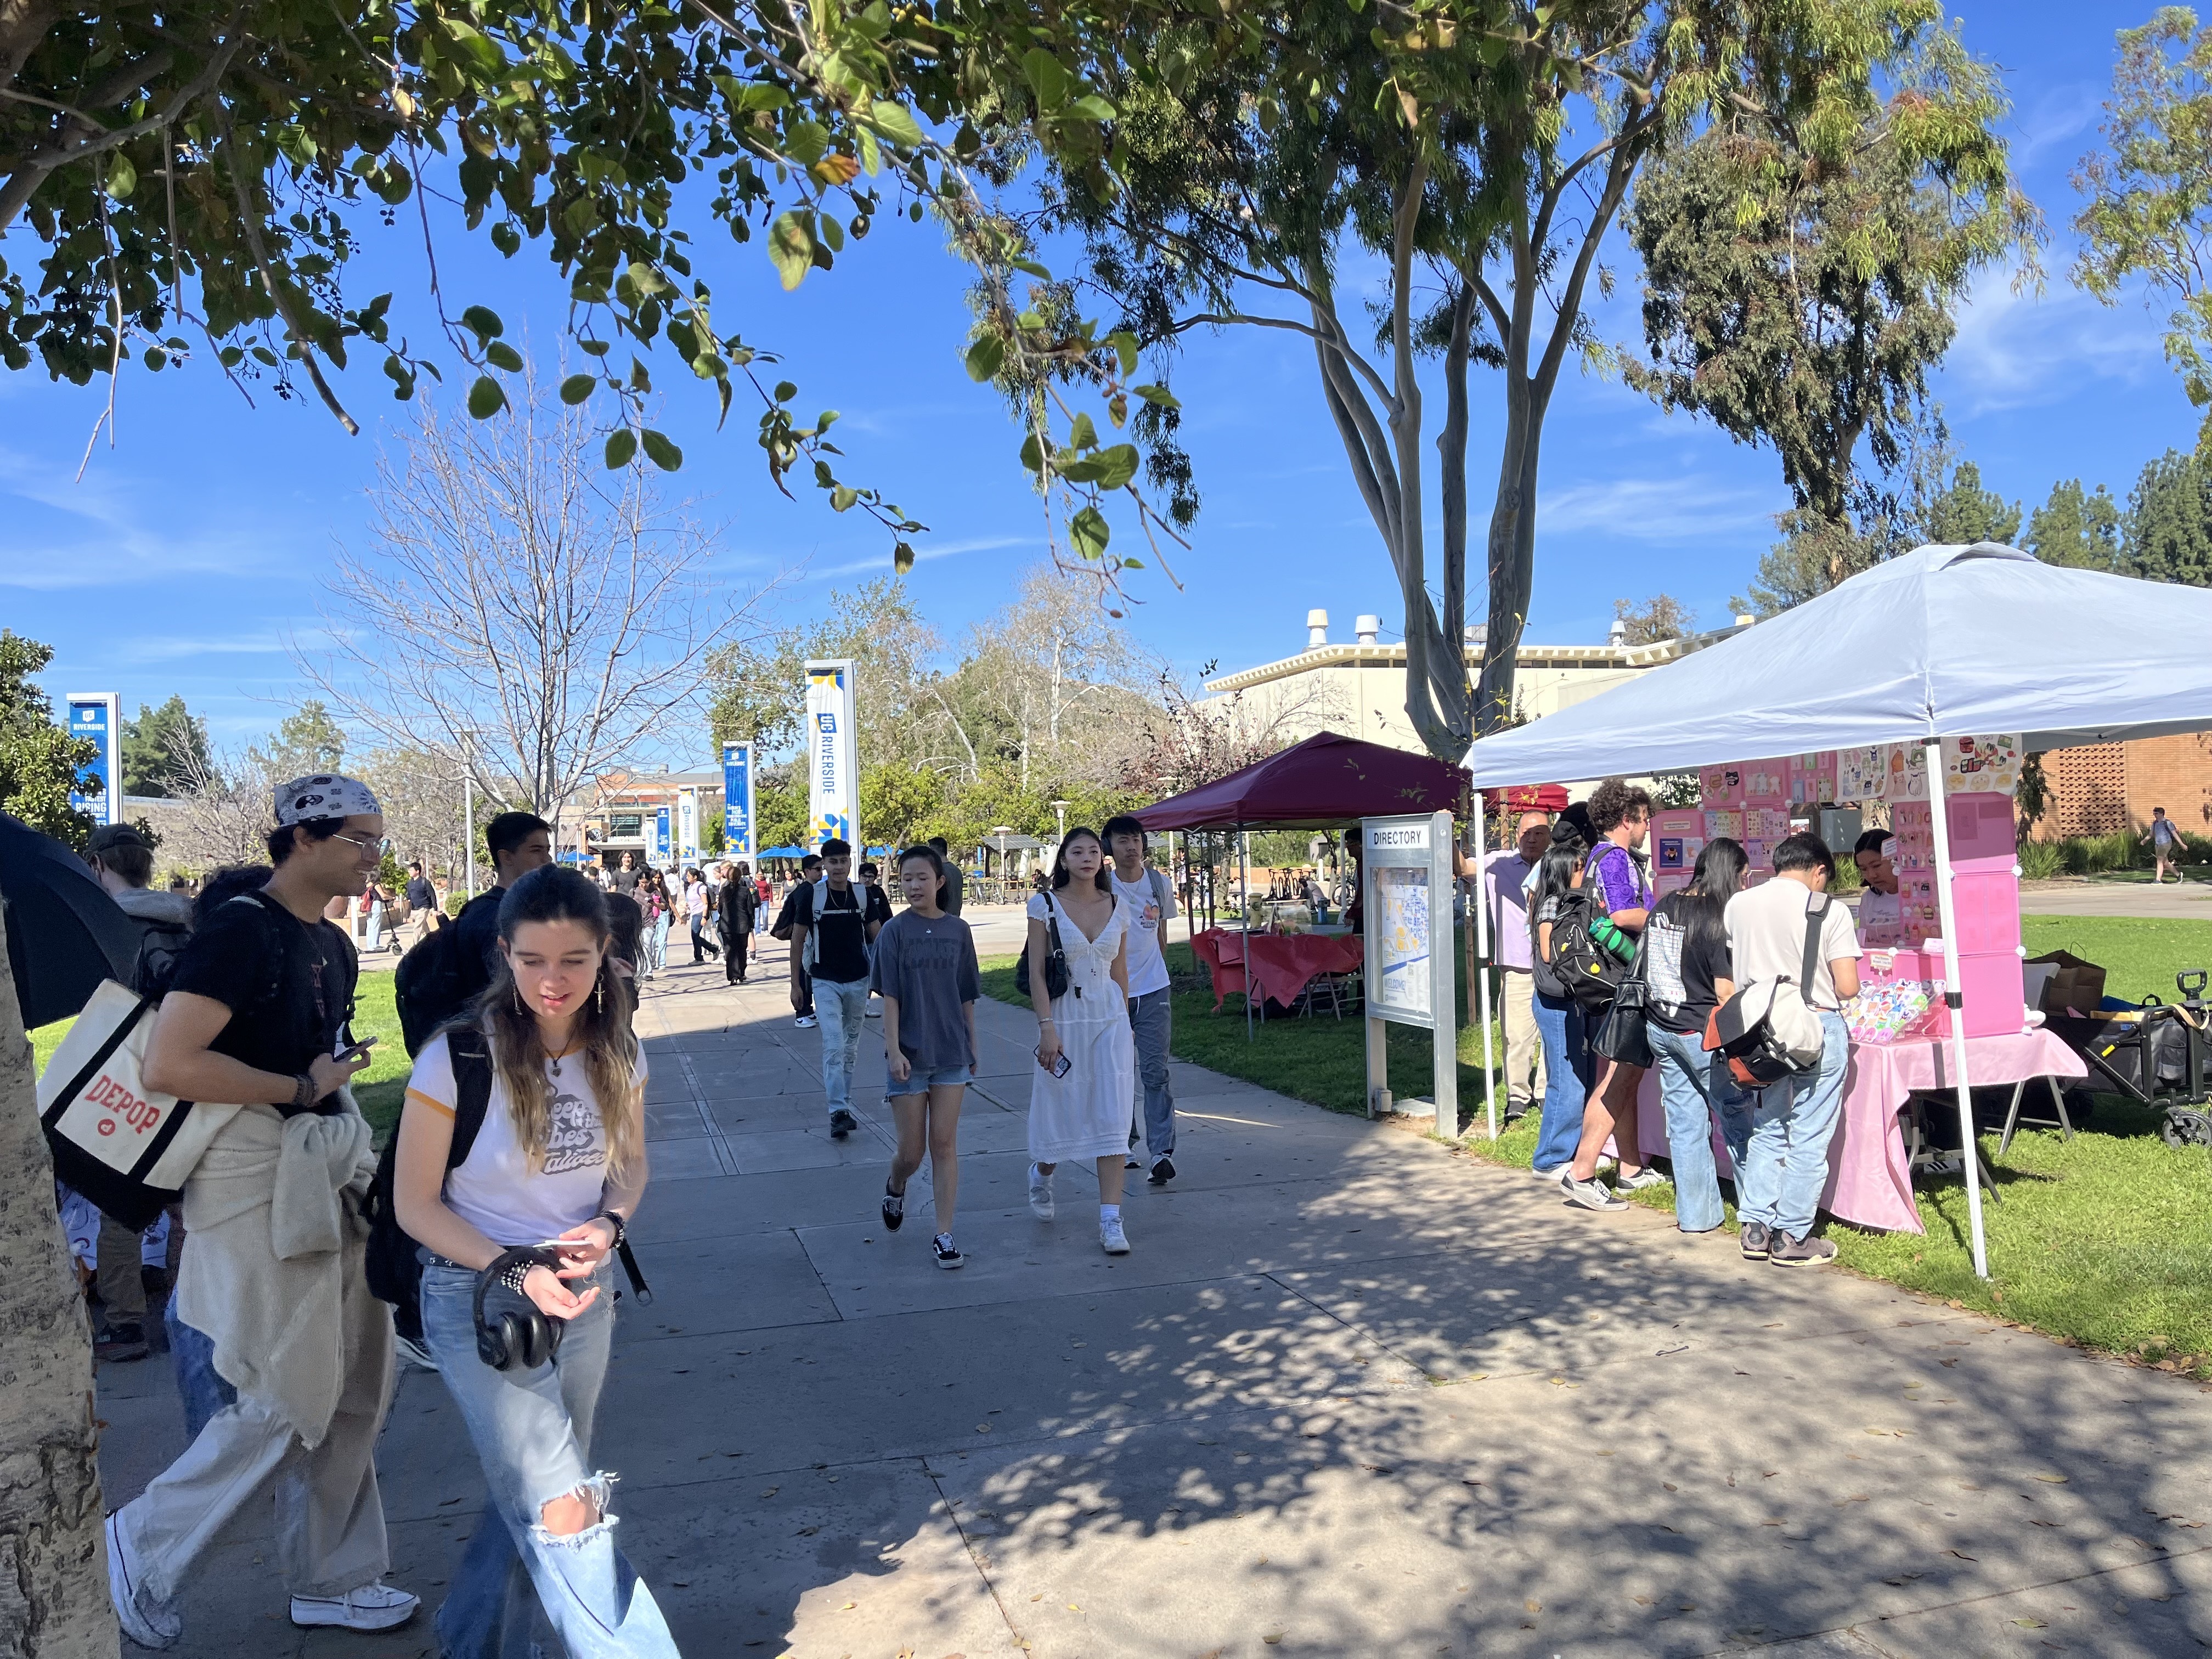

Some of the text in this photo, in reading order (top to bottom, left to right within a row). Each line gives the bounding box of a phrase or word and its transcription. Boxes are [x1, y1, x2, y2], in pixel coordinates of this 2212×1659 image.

[820, 715, 835, 794] UC RIVERSIDE
[76, 803, 106, 812] RISING
[1374, 830, 1421, 845] DIRECTORY
[84, 1074, 160, 1135] DEPOP
[550, 1101, 586, 1127] eep
